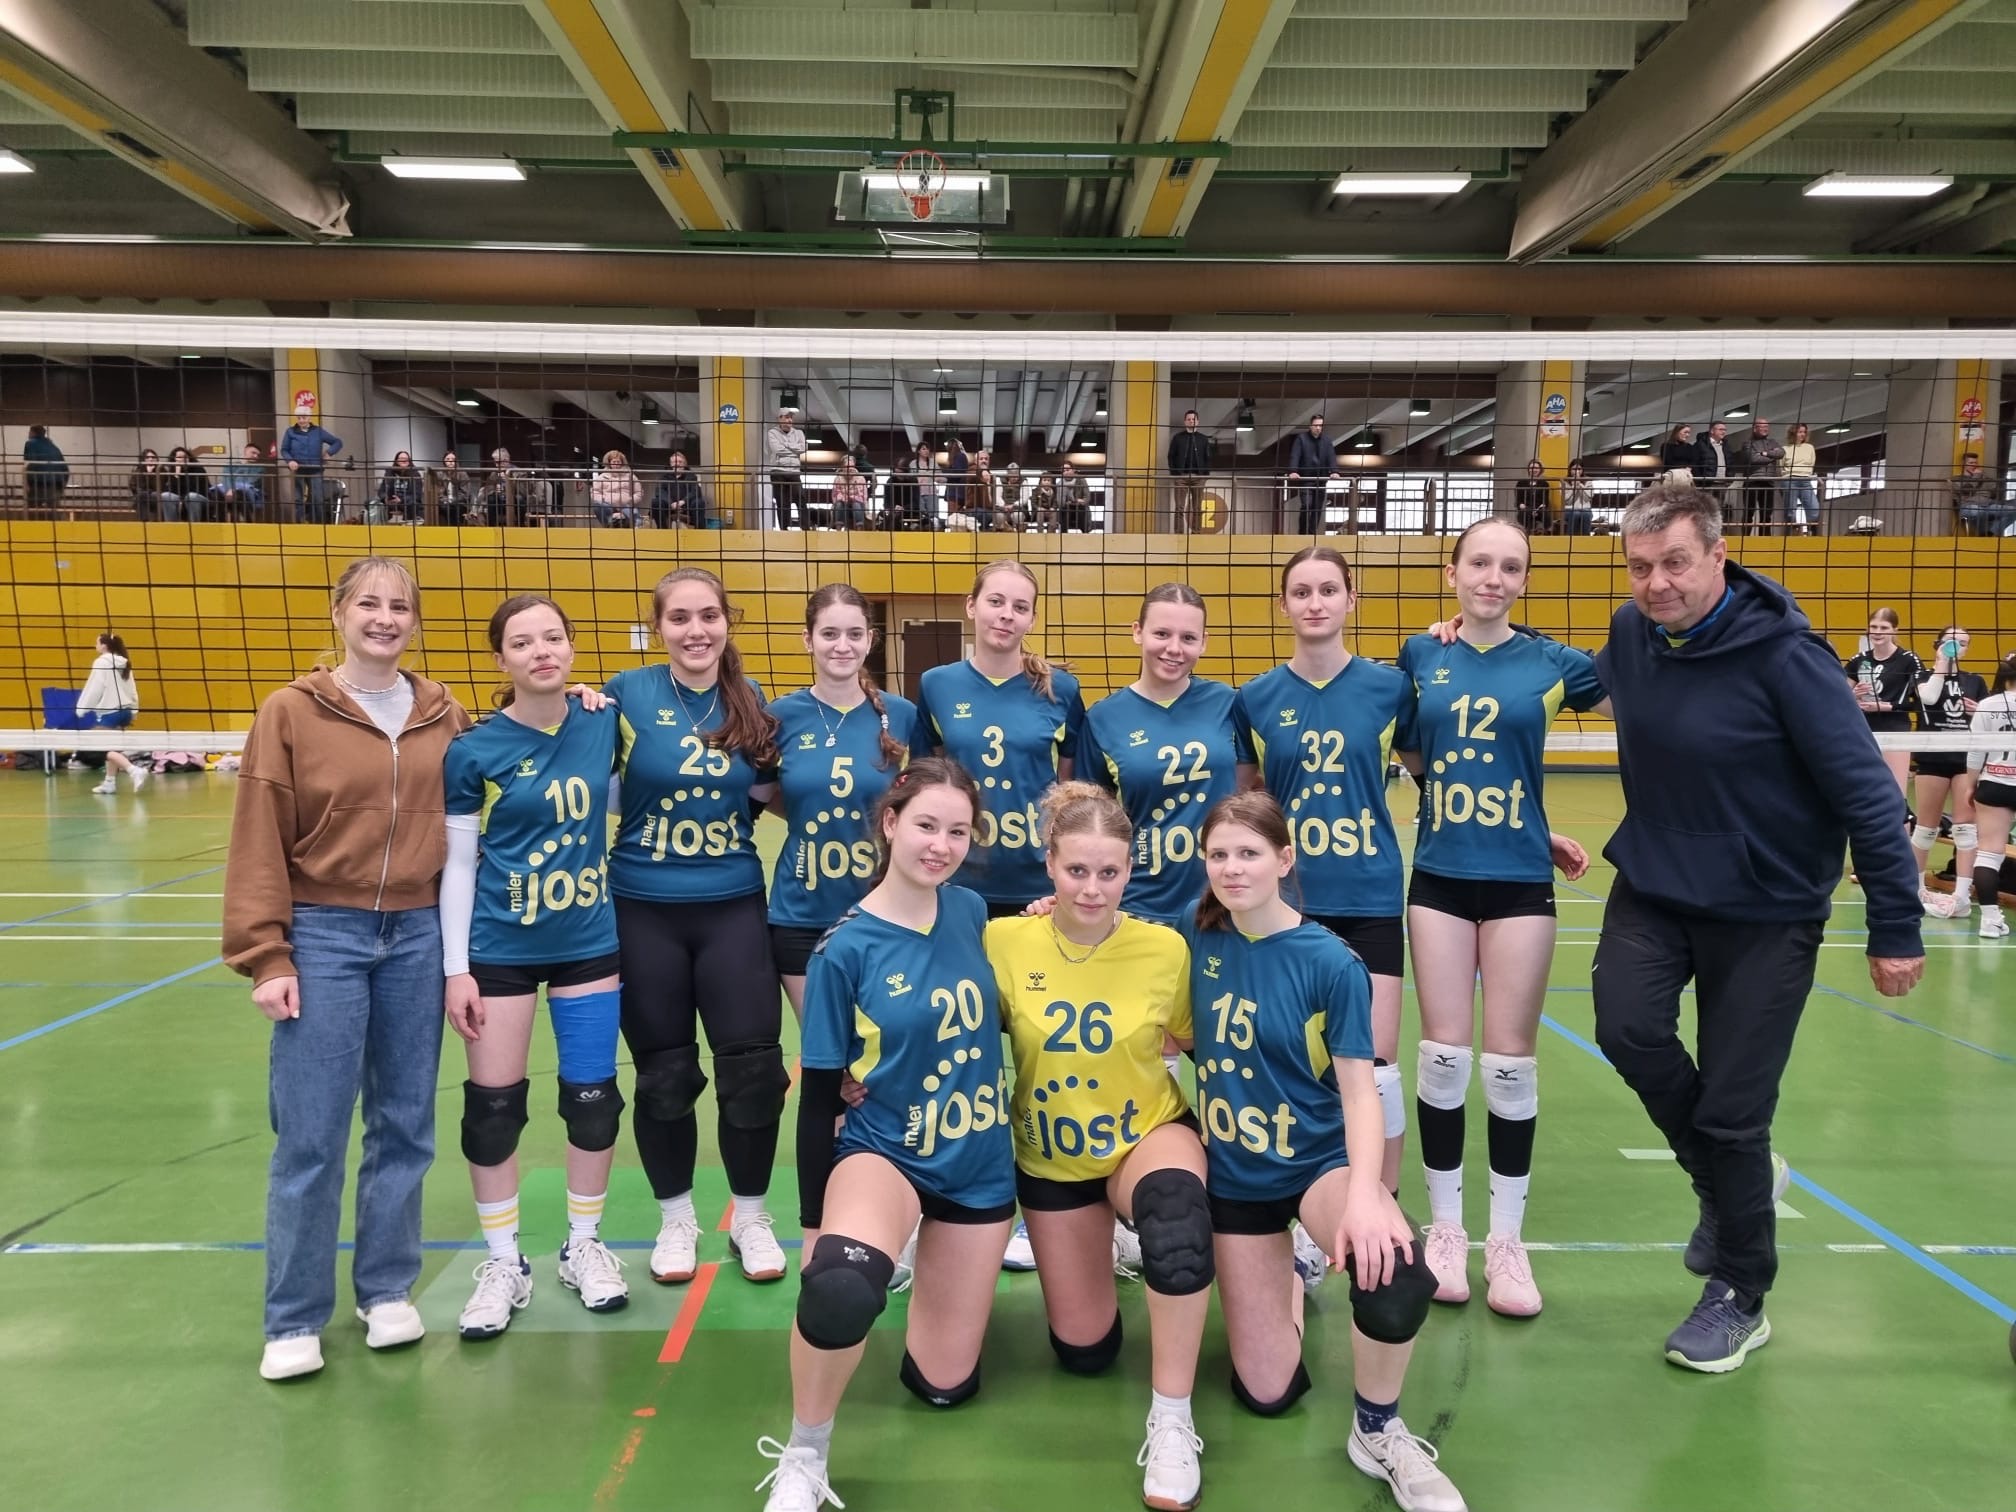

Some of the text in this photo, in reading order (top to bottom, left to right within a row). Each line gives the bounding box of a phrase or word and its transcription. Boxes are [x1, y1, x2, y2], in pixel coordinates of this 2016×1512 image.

[720, 407, 738, 419] AHA
[1546, 397, 1566, 409] AHA
[1450, 694, 1500, 741] 12
[678, 736, 731, 777] 25
[981, 725, 1005, 767] 3
[1157, 741, 1211, 786] 22
[1301, 730, 1345, 773] 32
[829, 756, 854, 798] 5
[544, 776, 591, 824] 10
[1432, 778, 1525, 832] jost
[640, 813, 657, 848] maler
[651, 811, 741, 862] jost
[972, 802, 1042, 848] ost
[1136, 826, 1148, 866] maler
[1287, 807, 1378, 862] jost
[795, 838, 807, 879] maler
[505, 871, 523, 914] maler
[520, 854, 609, 926] jost
[930, 978, 984, 1043] 20
[1025, 984, 1047, 992] hummel
[1043, 1000, 1114, 1055] 26
[1211, 992, 1257, 1050] 15
[904, 1104, 922, 1147] maler
[916, 1067, 1009, 1157] jost
[1023, 1106, 1038, 1146] maler
[1038, 1099, 1141, 1160] jost
[1199, 1088, 1298, 1158] jost
